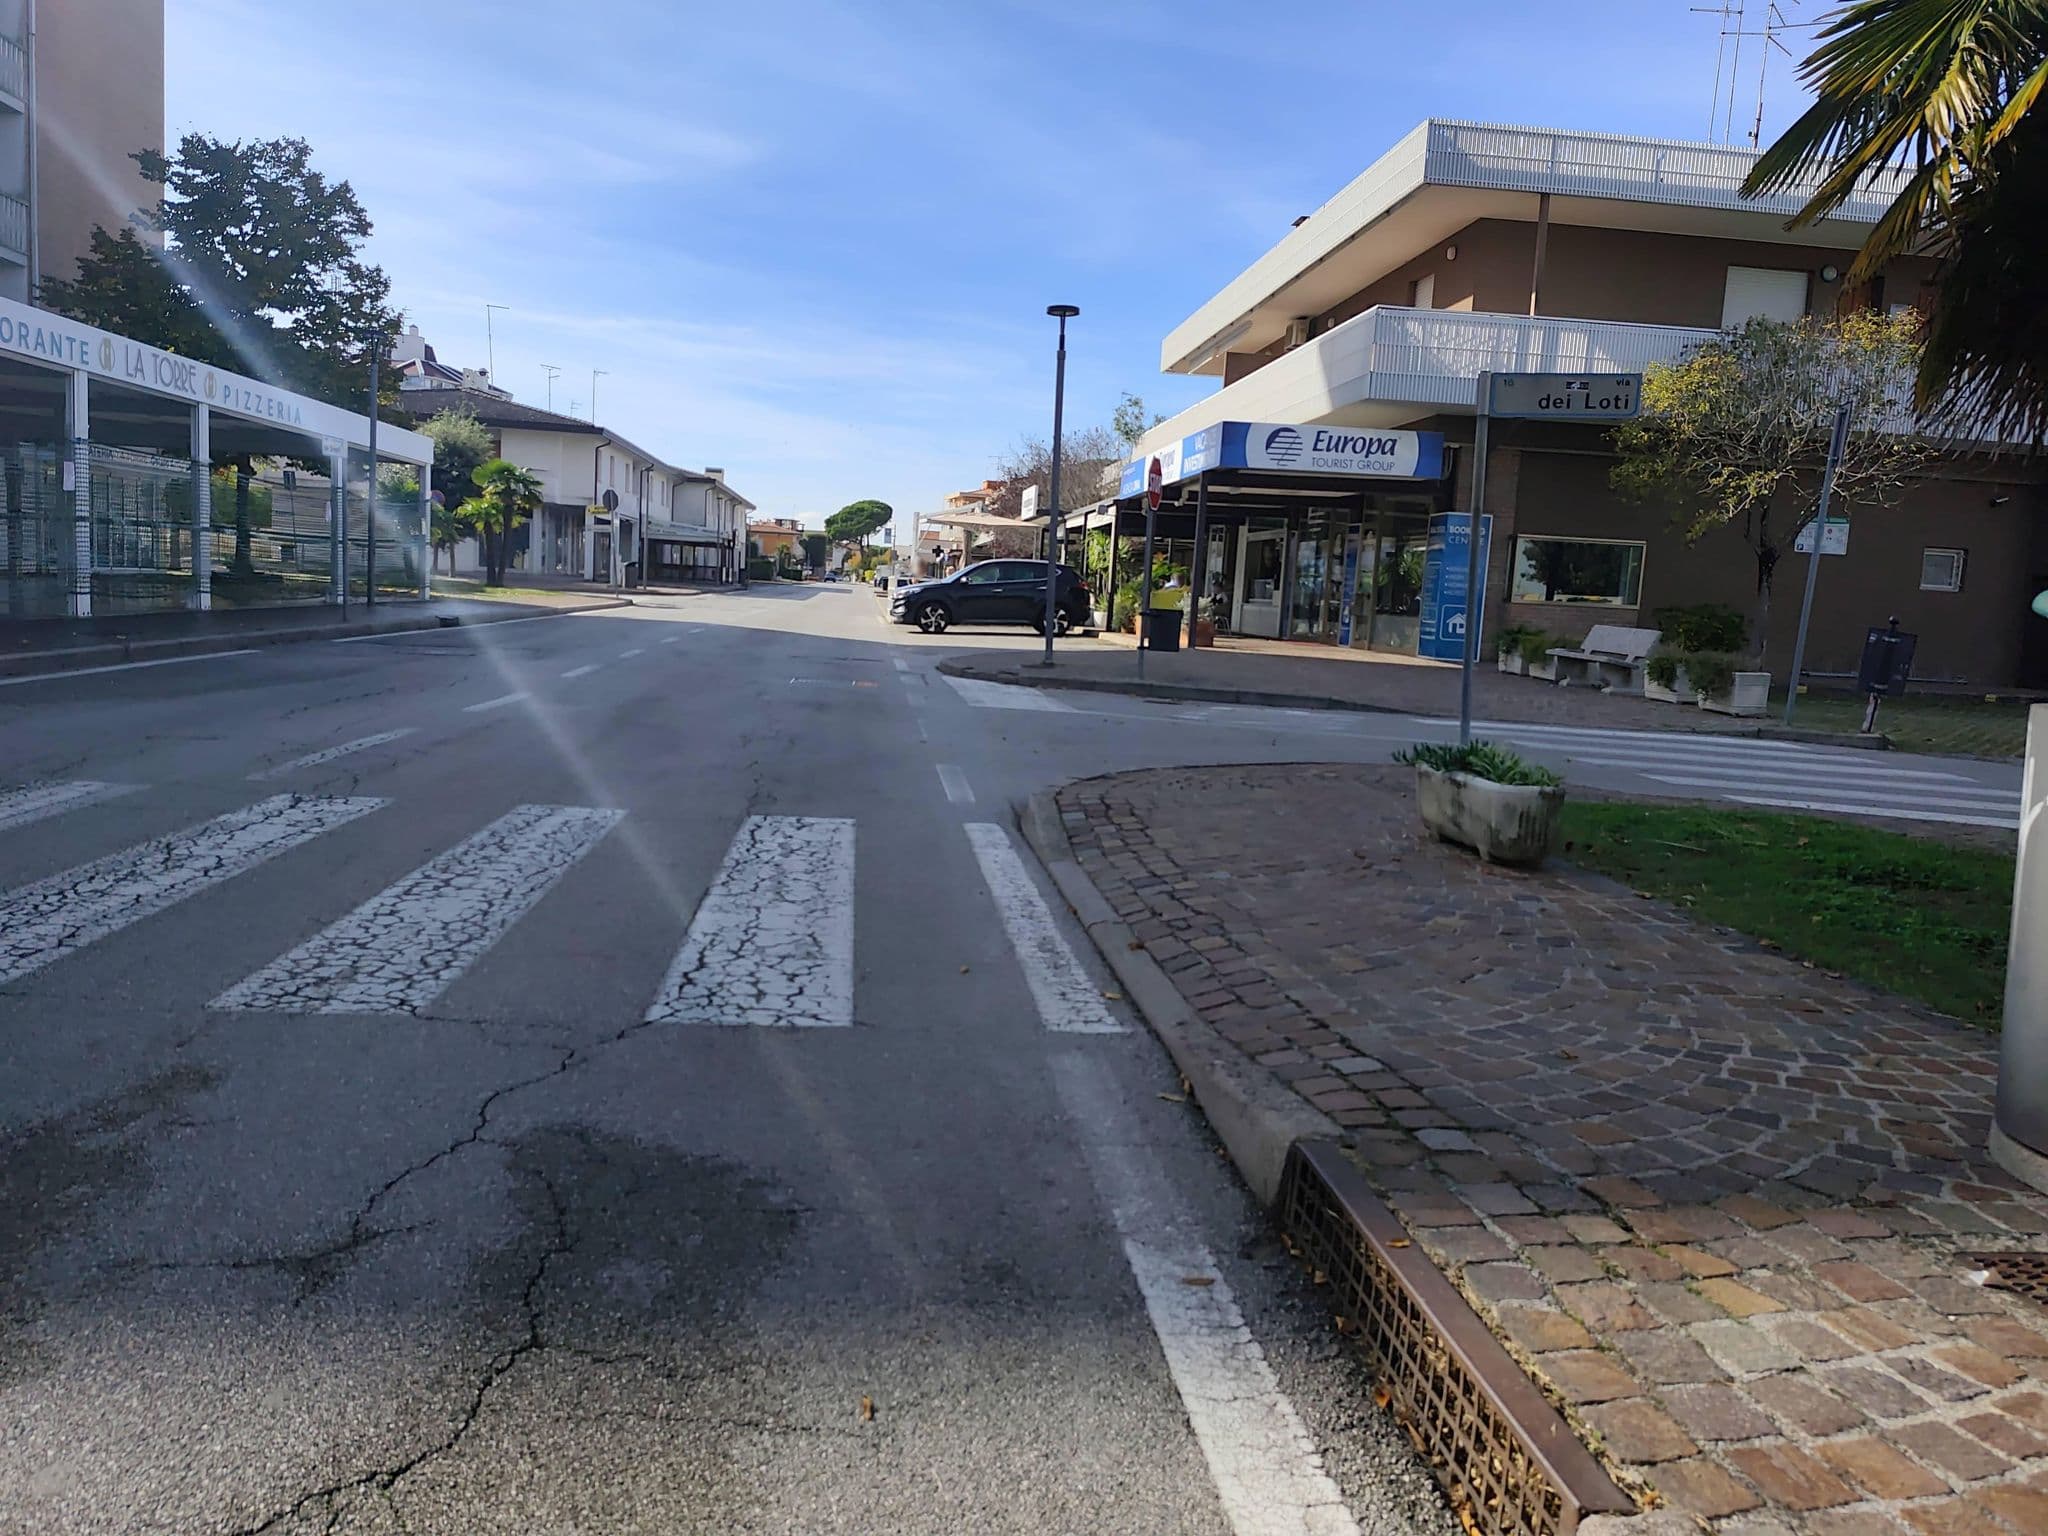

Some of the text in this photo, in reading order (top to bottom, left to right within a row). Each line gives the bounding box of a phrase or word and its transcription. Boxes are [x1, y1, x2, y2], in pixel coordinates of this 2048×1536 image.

[126, 345, 145, 381] LA
[152, 353, 196, 395] TORRE
[223, 384, 301, 424] PIZZERIA
[1615, 378, 1631, 386] via
[1538, 393, 1629, 409] dei Loti
[1312, 430, 1397, 458] Europa
[1312, 457, 1395, 471] TOURIST GROUP
